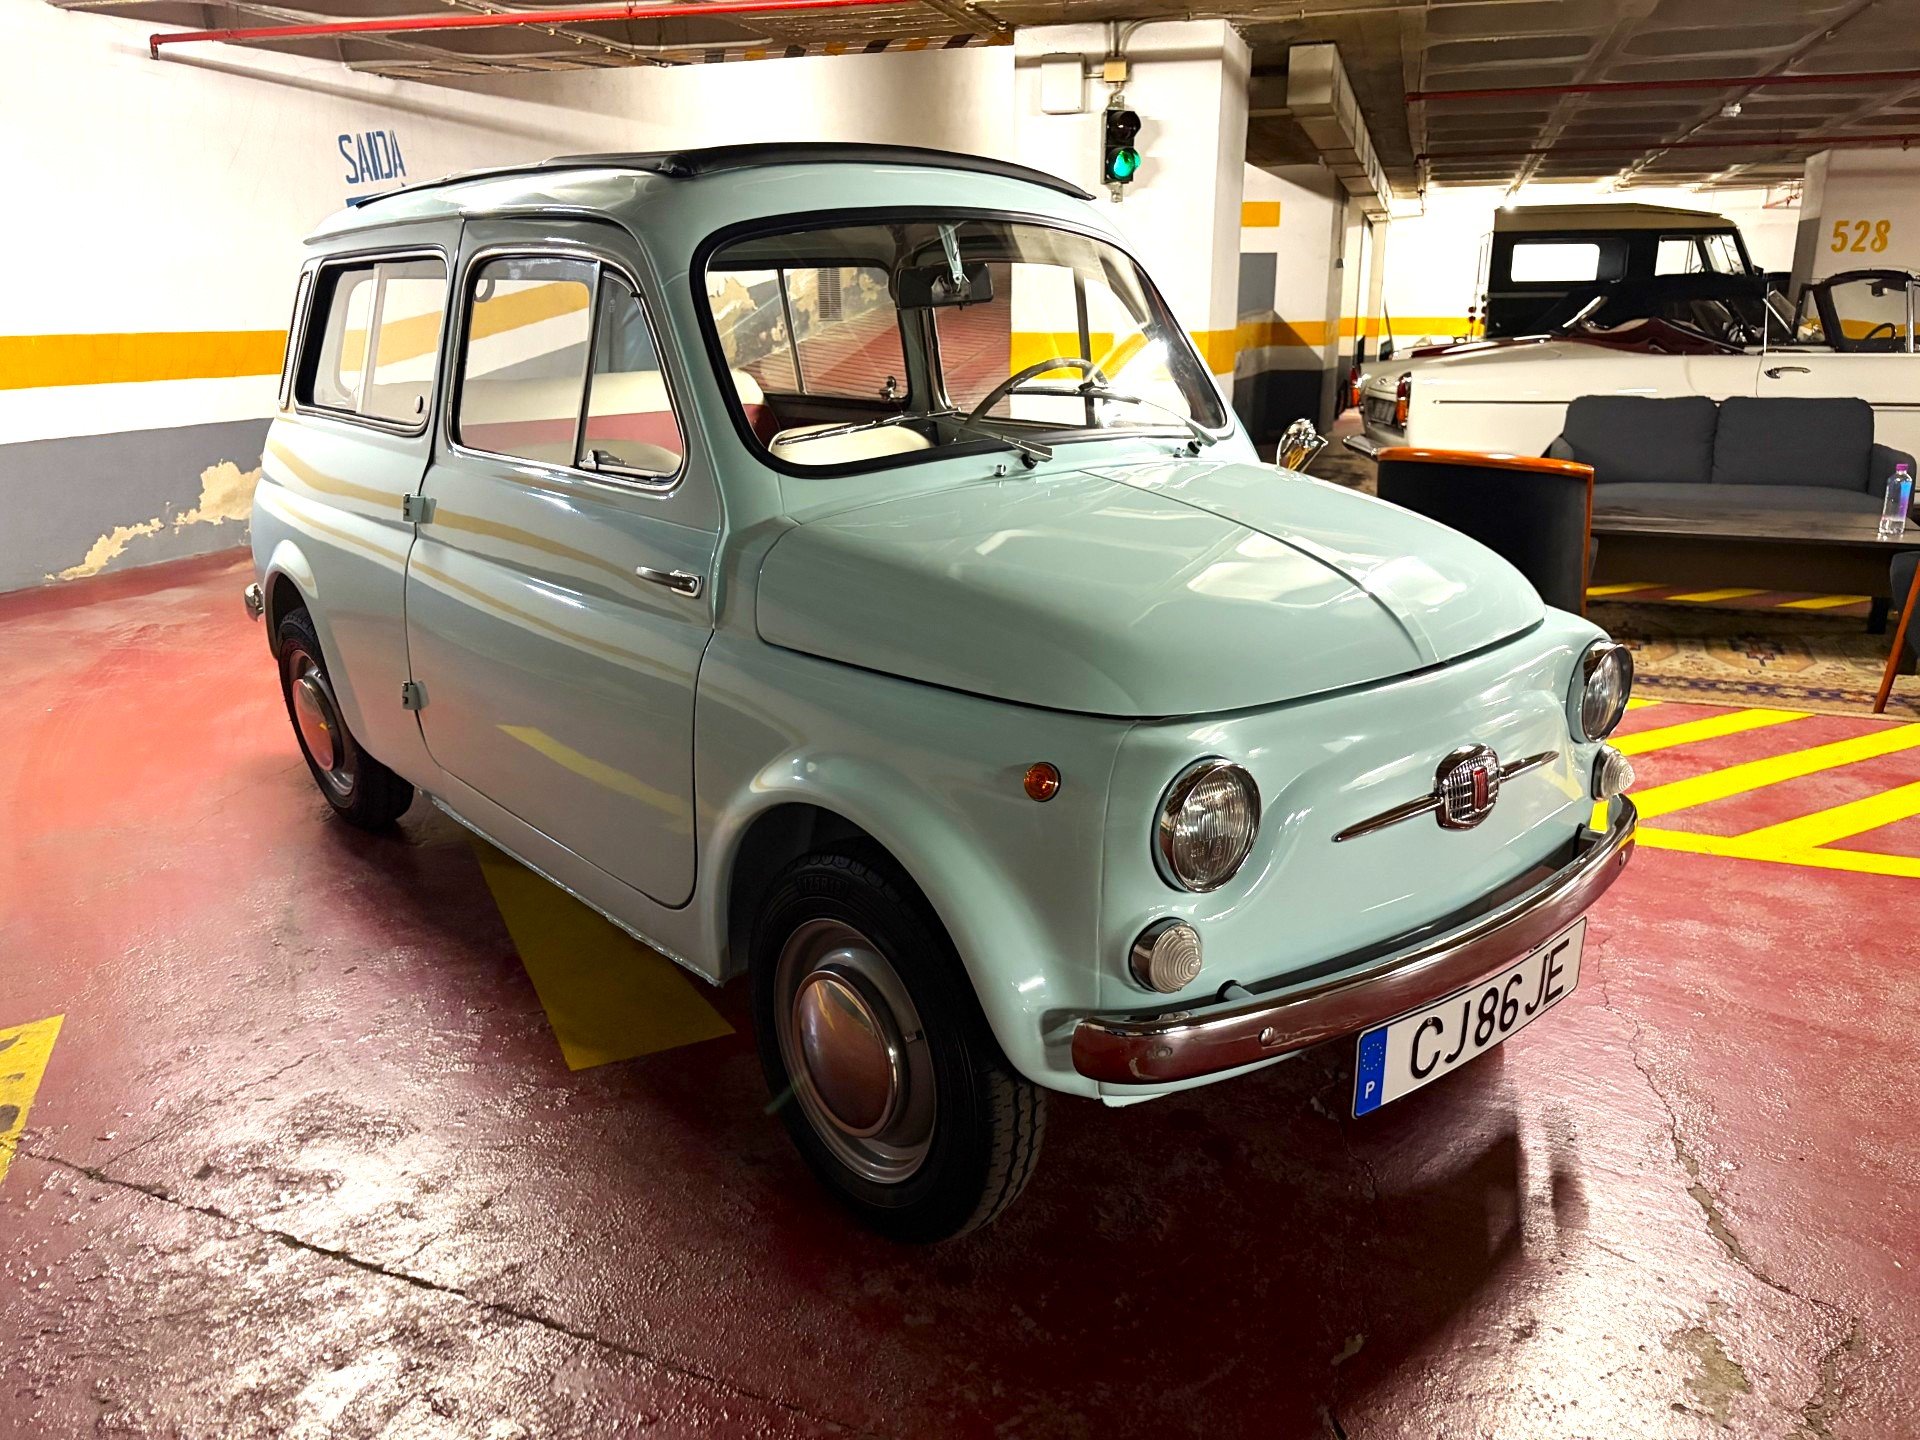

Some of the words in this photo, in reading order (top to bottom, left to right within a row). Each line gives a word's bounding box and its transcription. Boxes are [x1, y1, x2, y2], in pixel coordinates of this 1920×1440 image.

[337, 129, 407, 184] SAIDA
[1830, 219, 1892, 253] 528
[1364, 1080, 1376, 1100] P
